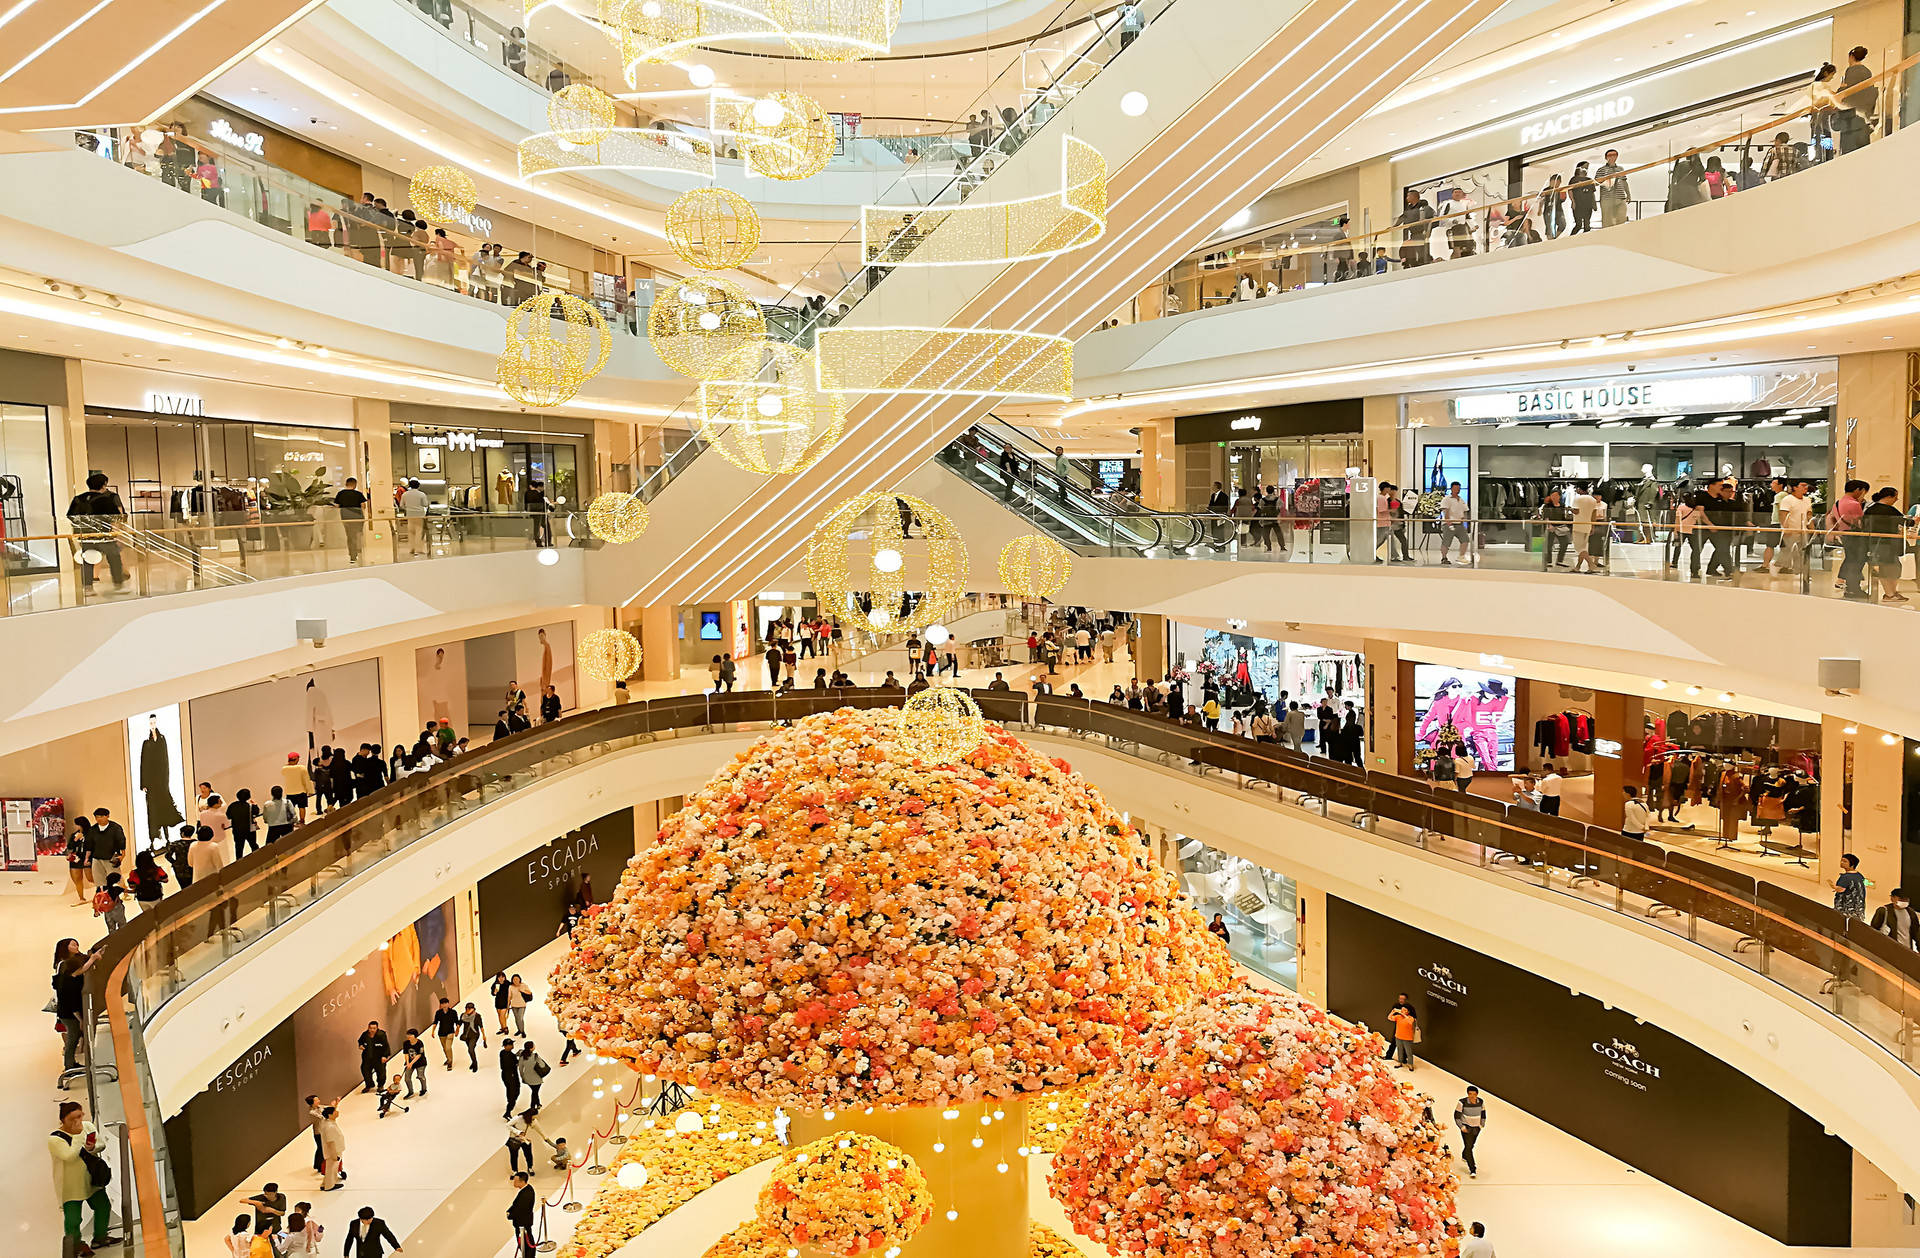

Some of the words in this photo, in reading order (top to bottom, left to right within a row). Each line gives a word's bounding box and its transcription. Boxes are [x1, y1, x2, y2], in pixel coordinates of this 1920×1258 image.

[1521, 96, 1635, 145] PEACEBIRD
[1518, 391, 1574, 412] BASIC
[1582, 385, 1653, 409] HOUSE
[1355, 482, 1369, 493] L3
[527, 834, 599, 885] ESCADA
[322, 979, 367, 1018] ESCADA
[1417, 967, 1468, 996] COACH
[216, 1045, 272, 1092] ESCADA
[1592, 1042, 1661, 1079] COACH
[1604, 1068, 1630, 1085] coming
[1629, 1080, 1648, 1092] soon
